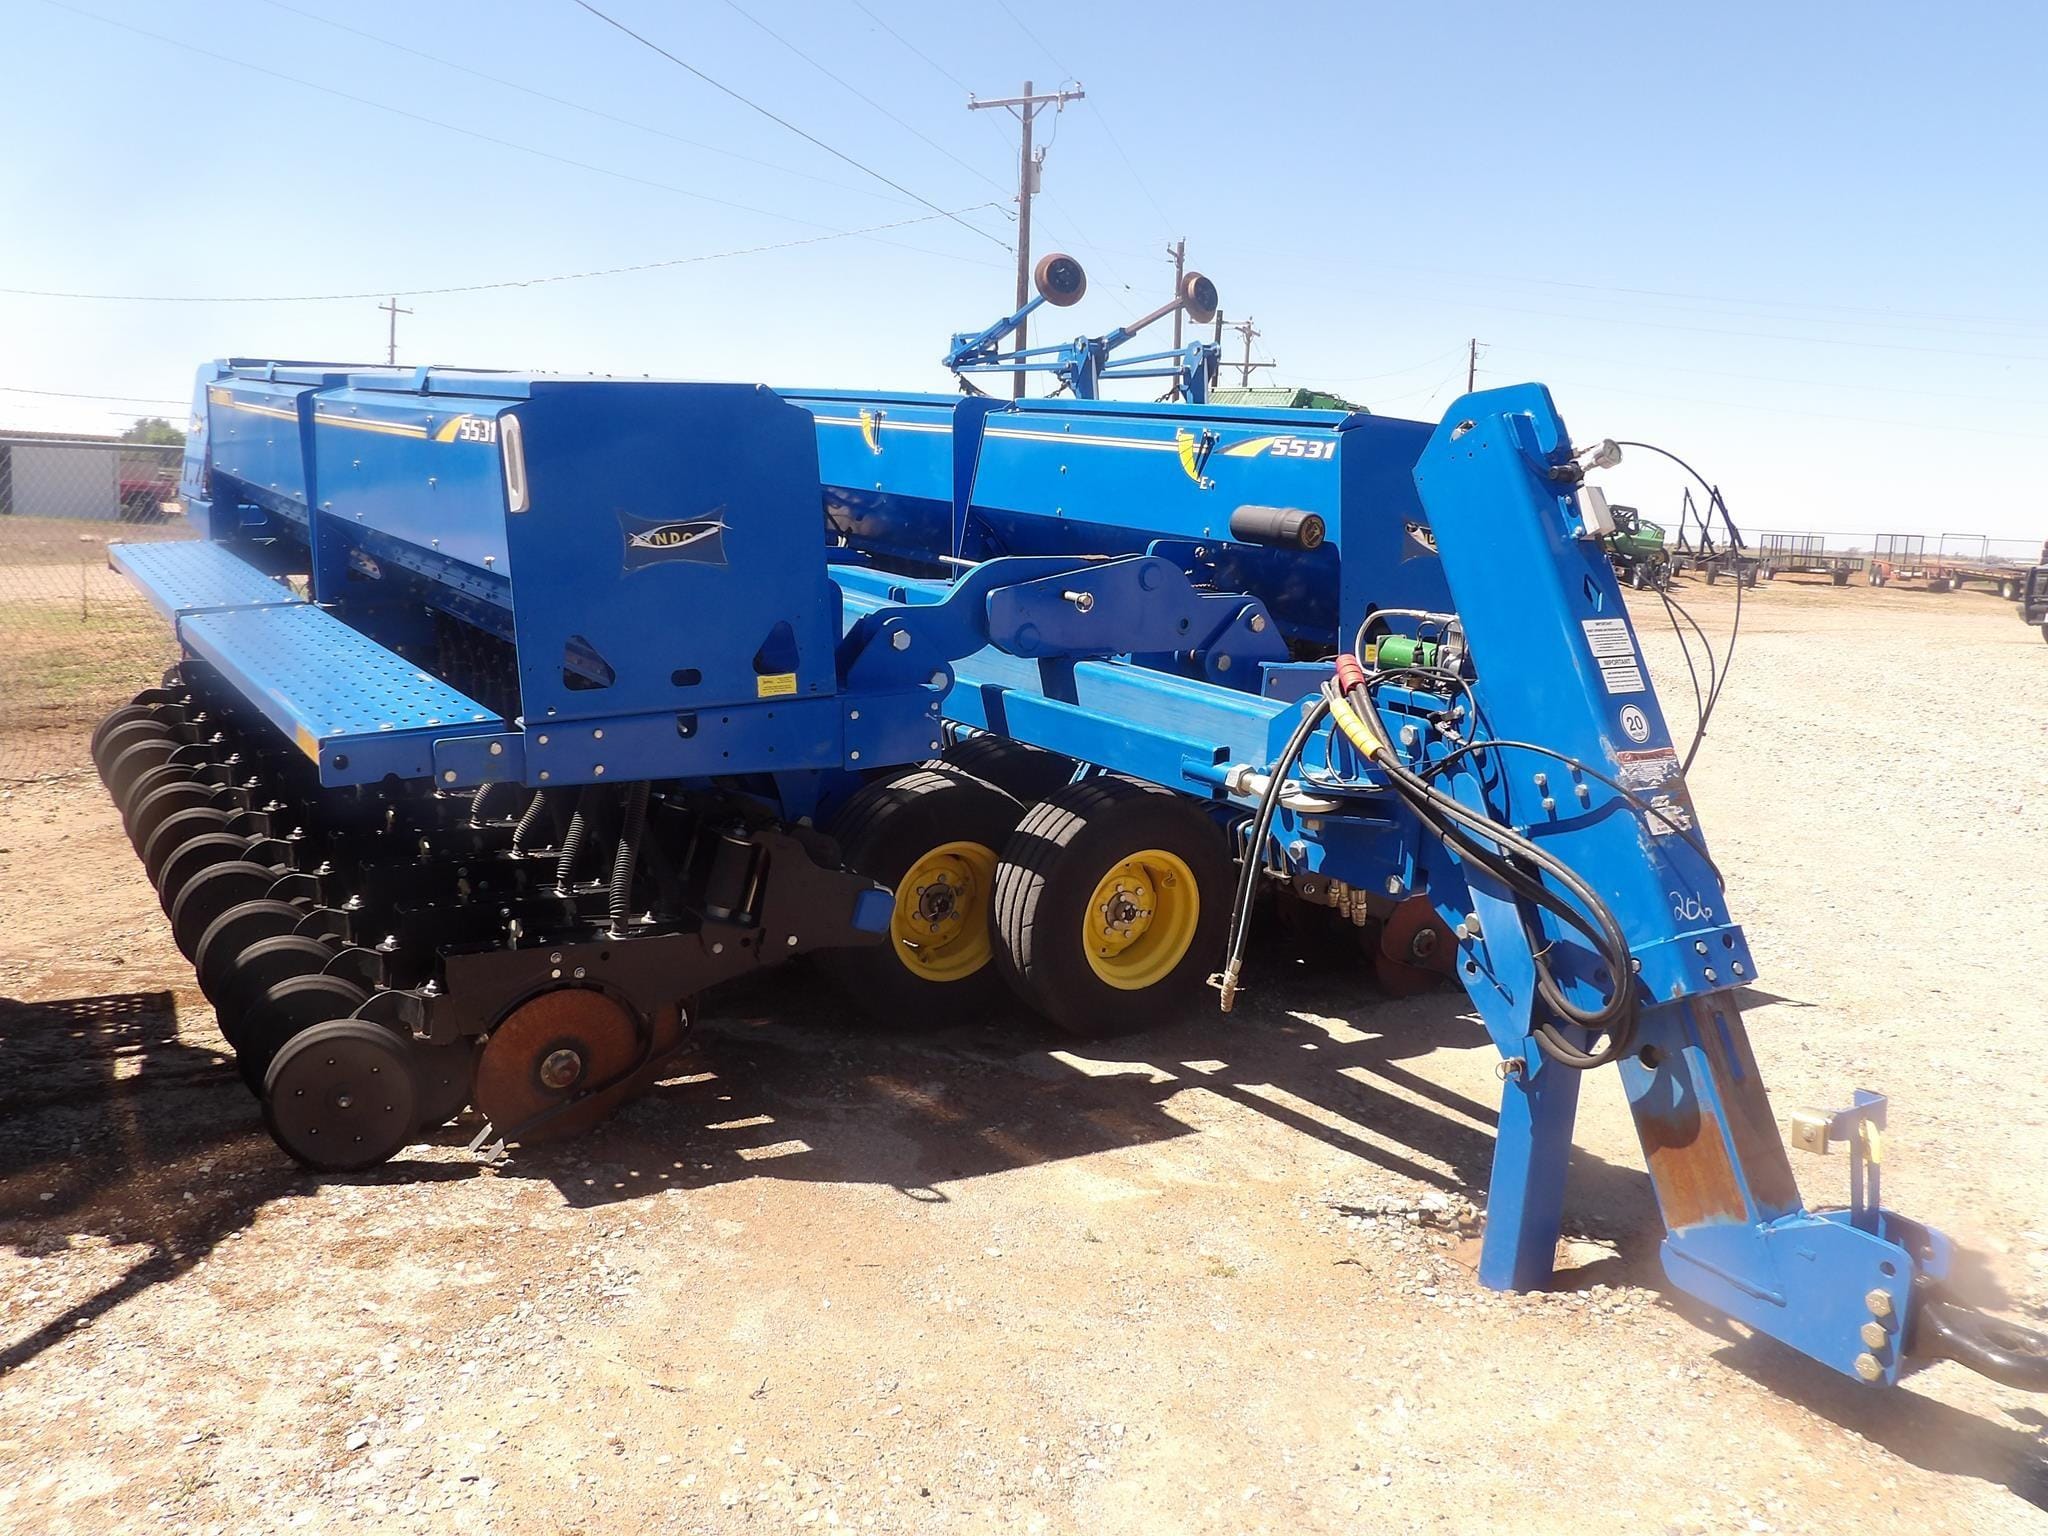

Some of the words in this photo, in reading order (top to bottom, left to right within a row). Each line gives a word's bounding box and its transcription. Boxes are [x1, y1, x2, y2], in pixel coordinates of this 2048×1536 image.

[460, 418, 497, 442] 5531
[1270, 438, 1336, 459] 5531
[1200, 476, 1208, 489] E
[1626, 715, 1643, 731] 20
